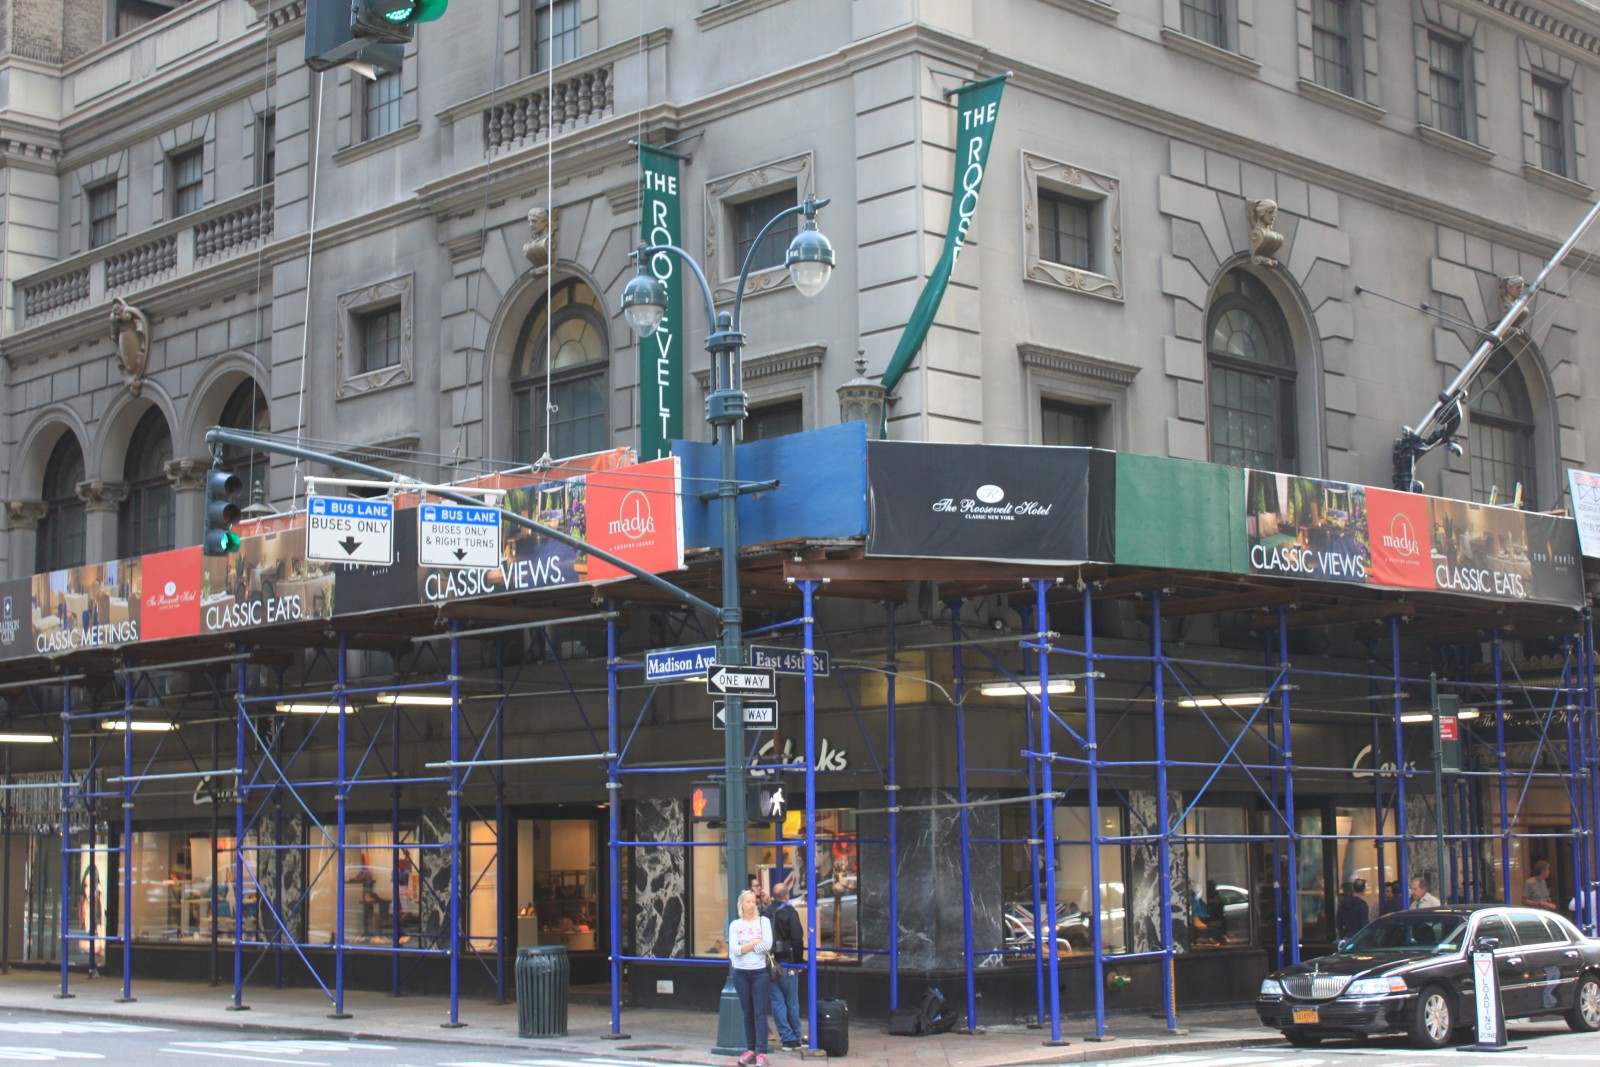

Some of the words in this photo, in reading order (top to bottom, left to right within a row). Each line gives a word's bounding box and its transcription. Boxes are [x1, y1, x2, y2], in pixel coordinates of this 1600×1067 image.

[963, 102, 996, 130] THE
[645, 171, 676, 195] THE
[331, 502, 354, 514] BUS
[357, 504, 389, 517] LANE
[441, 510, 463, 521] BUS
[467, 512, 496, 523] LANE
[932, 498, 957, 512] The
[960, 499, 1013, 514] Roosevelt
[1014, 501, 1052, 515] Hotel
[312, 517, 352, 530] BUSES
[357, 521, 388, 534] ONLY
[432, 524, 461, 535] BUSES
[465, 526, 488, 536] ONLY
[426, 536, 432, 545] &
[435, 536, 461, 546] RIGHT
[465, 538, 494, 548] TURNS
[1251, 545, 1314, 573] CLASSIC
[1317, 551, 1368, 578] VIEWS.
[425, 567, 495, 600] CLASSIC
[500, 555, 565, 590] VIEWS.
[1436, 565, 1491, 593] CLASSIC
[1494, 571, 1527, 597] EATS.
[206, 600, 262, 630] CLASSIC
[267, 594, 303, 622] EATS.
[37, 628, 78, 653] CLASSIC
[81, 620, 139, 647] MEETINGS.
[648, 656, 692, 674] Madison
[695, 653, 715, 669] Ave
[756, 651, 782, 668] East
[812, 656, 824, 671] St
[719, 674, 739, 686] ONE
[744, 676, 765, 687] WAY
[748, 710, 768, 720] WAY
[750, 738, 847, 776] Claks
[1482, 978, 1491, 1031] LOADING
